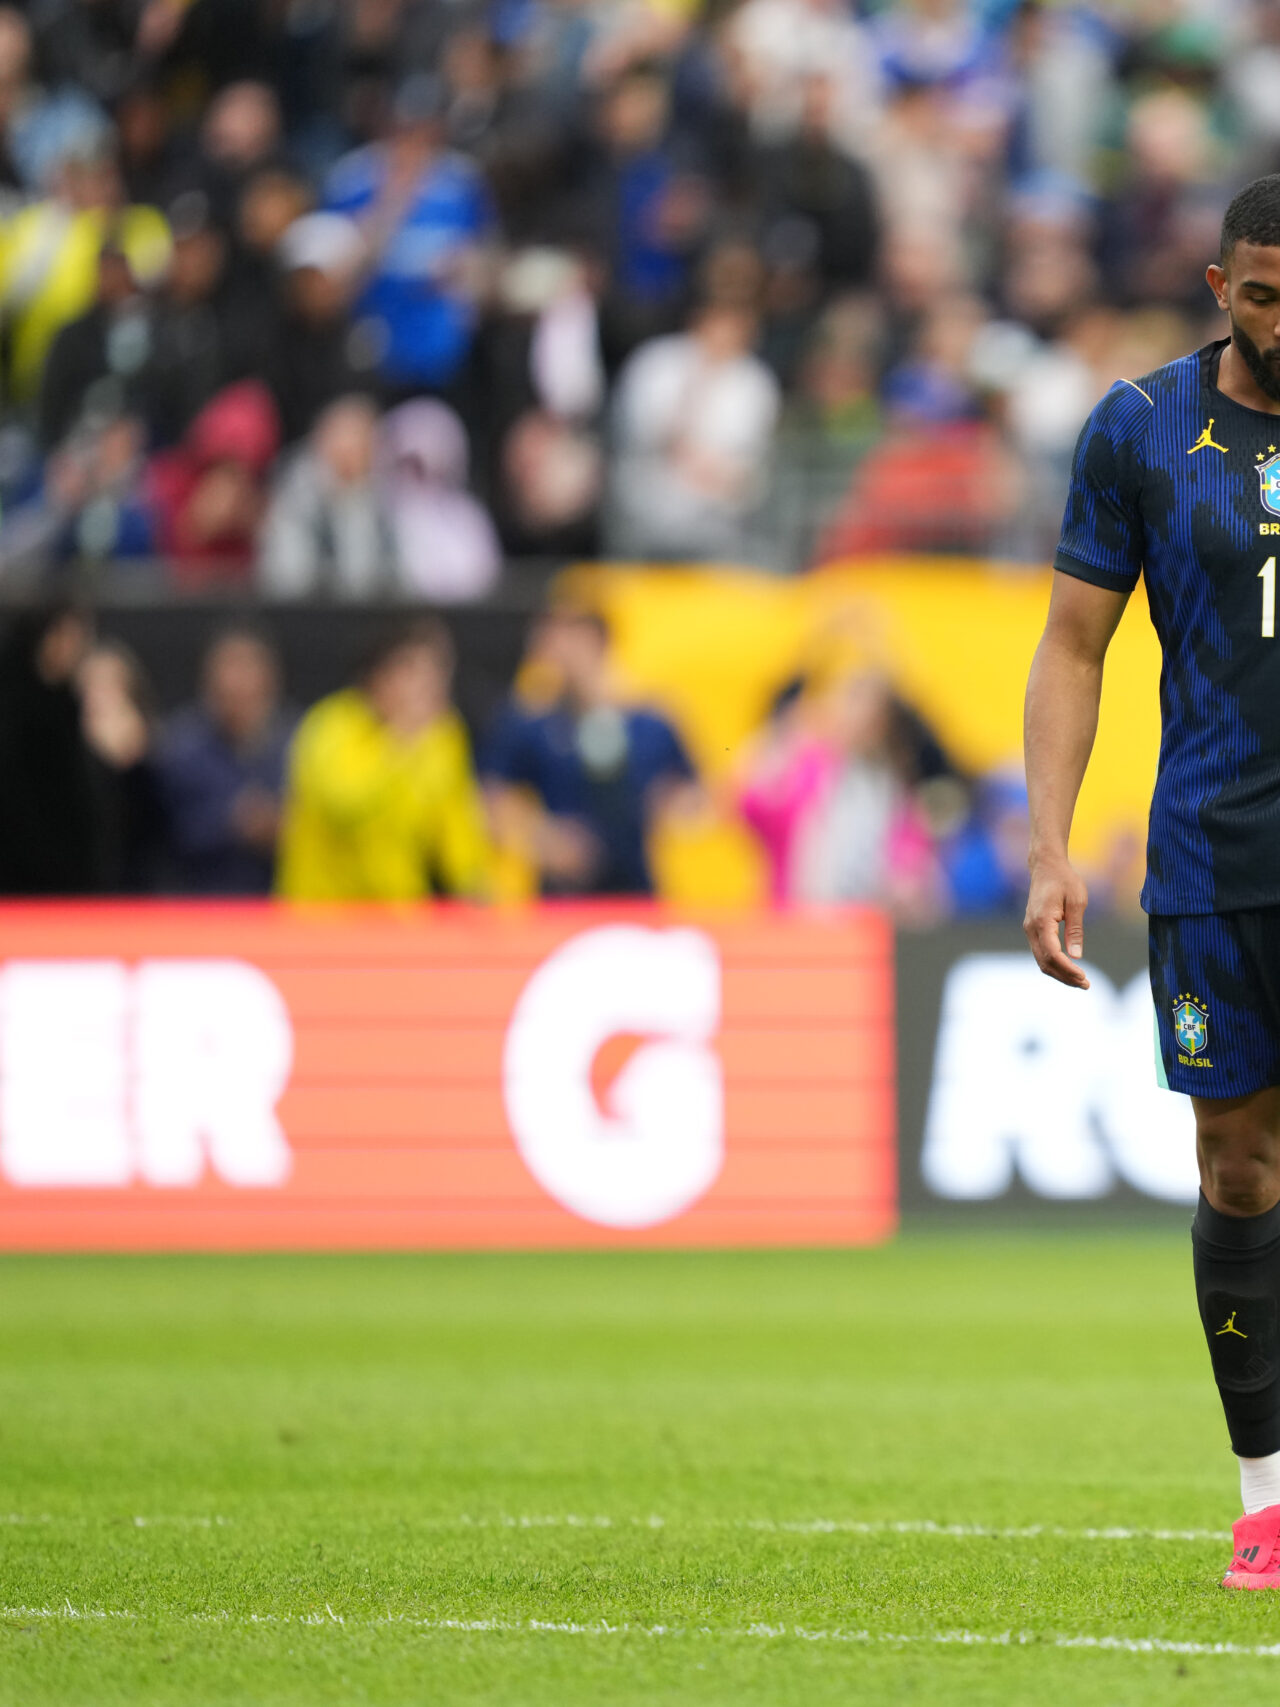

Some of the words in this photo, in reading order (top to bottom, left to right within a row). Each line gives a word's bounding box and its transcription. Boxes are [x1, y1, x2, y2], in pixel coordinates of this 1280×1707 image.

[1183, 1023, 1197, 1031] CBF
[1178, 1053, 1214, 1068] BRASIL
[0, 956, 295, 1188] ER
